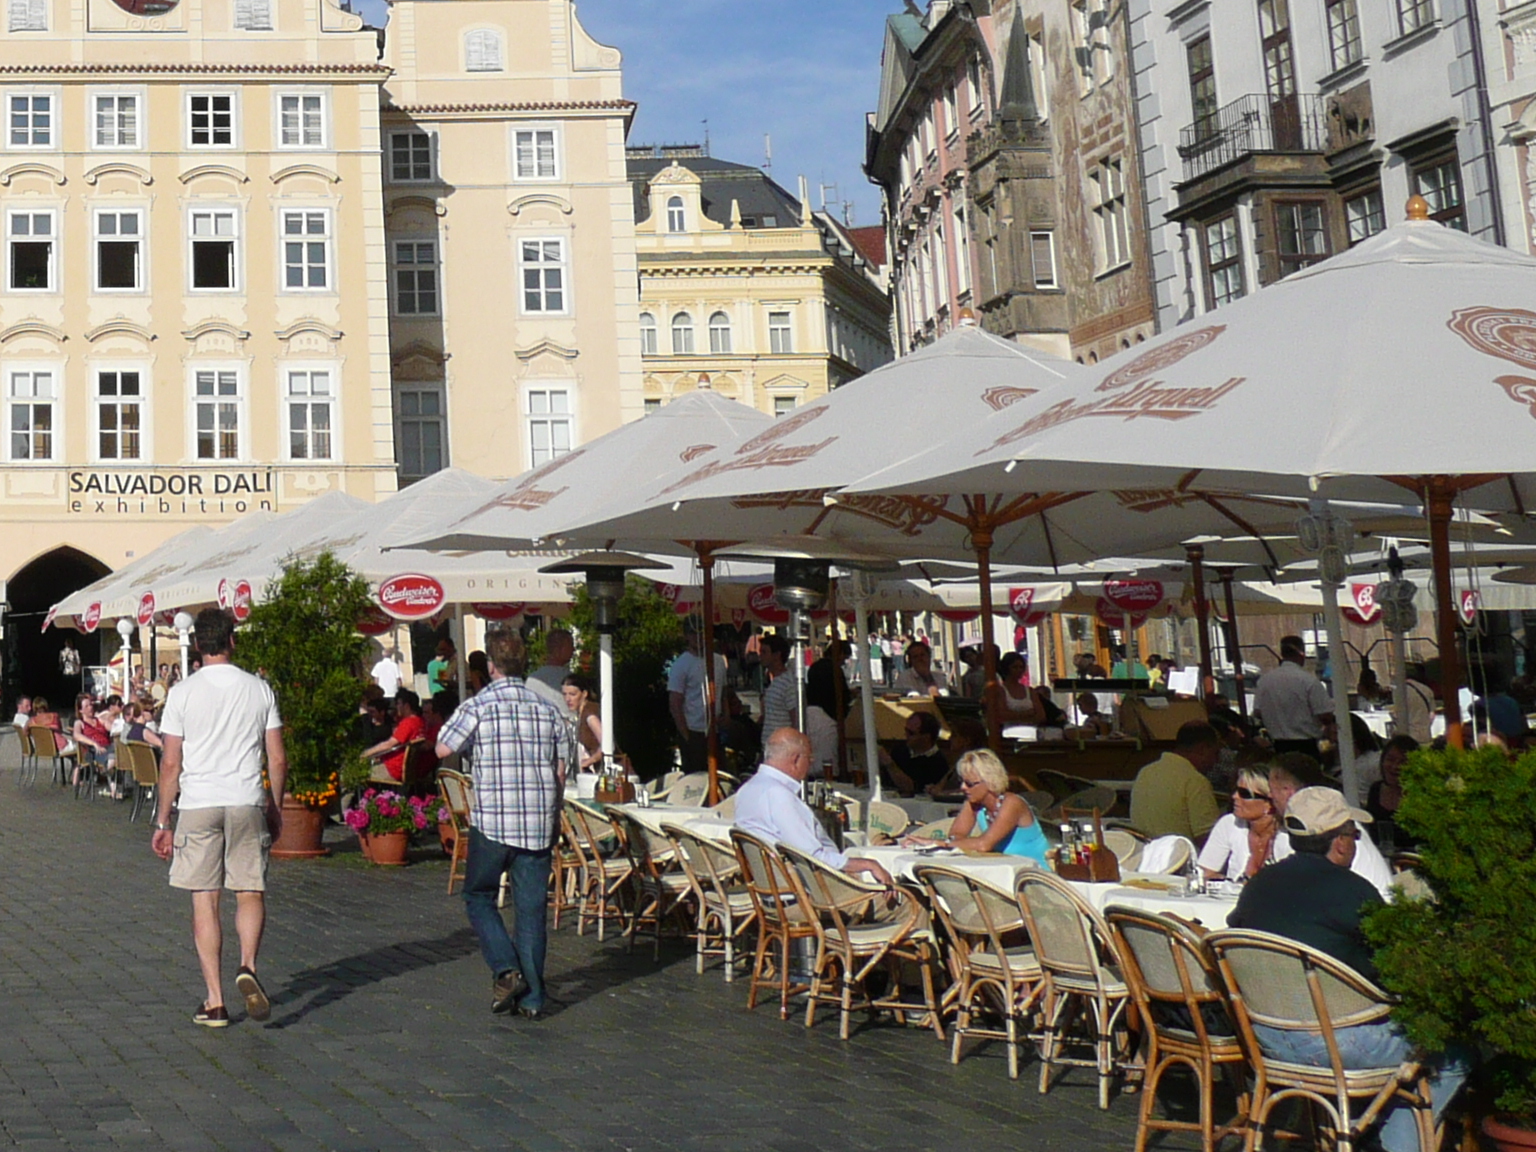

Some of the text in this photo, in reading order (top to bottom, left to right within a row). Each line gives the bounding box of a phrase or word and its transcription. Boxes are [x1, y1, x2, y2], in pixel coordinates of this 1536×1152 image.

[70, 466, 272, 495] SALVADOR DALÍ
[71, 497, 272, 513] exhibition
[467, 578, 563, 589] ORIGIN
[382, 585, 439, 604] Budweiser
